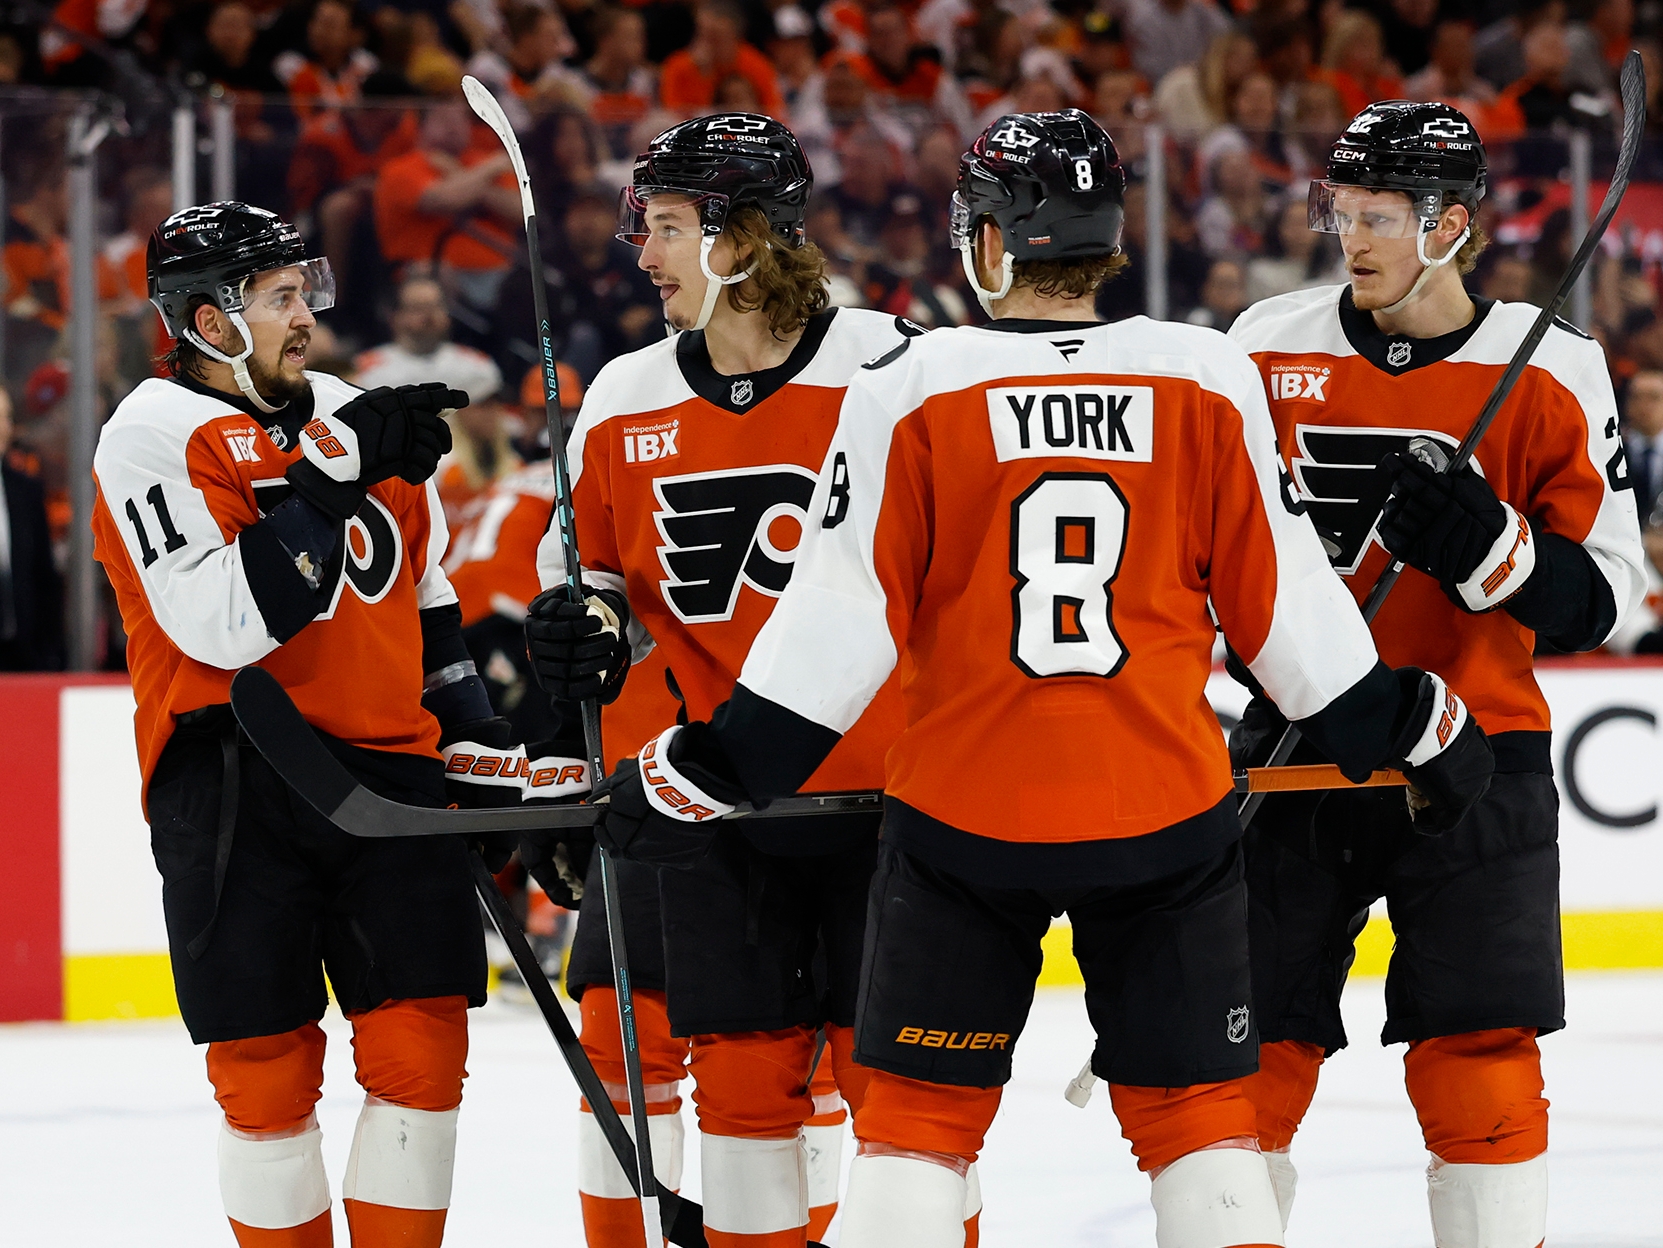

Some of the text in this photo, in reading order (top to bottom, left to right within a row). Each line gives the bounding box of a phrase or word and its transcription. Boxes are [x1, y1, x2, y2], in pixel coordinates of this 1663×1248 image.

[707, 133, 770, 145] CHEVROLET
[1423, 141, 1473, 151] CHEVROLET
[985, 149, 1031, 164] CHEVROLET
[1333, 149, 1367, 161] CCM
[1075, 159, 1094, 190] 8
[164, 222, 220, 240] CHEVROLET
[1271, 364, 1321, 374] Independence
[1271, 373, 1330, 402] IBX
[623, 422, 672, 434] Independence
[1006, 393, 1135, 453] YORK
[624, 428, 679, 463] IBX
[822, 451, 850, 529] 8
[125, 483, 188, 570] 11
[1009, 471, 1131, 679] 8
[642, 734, 716, 822] AUER
[1563, 706, 1657, 828] C
